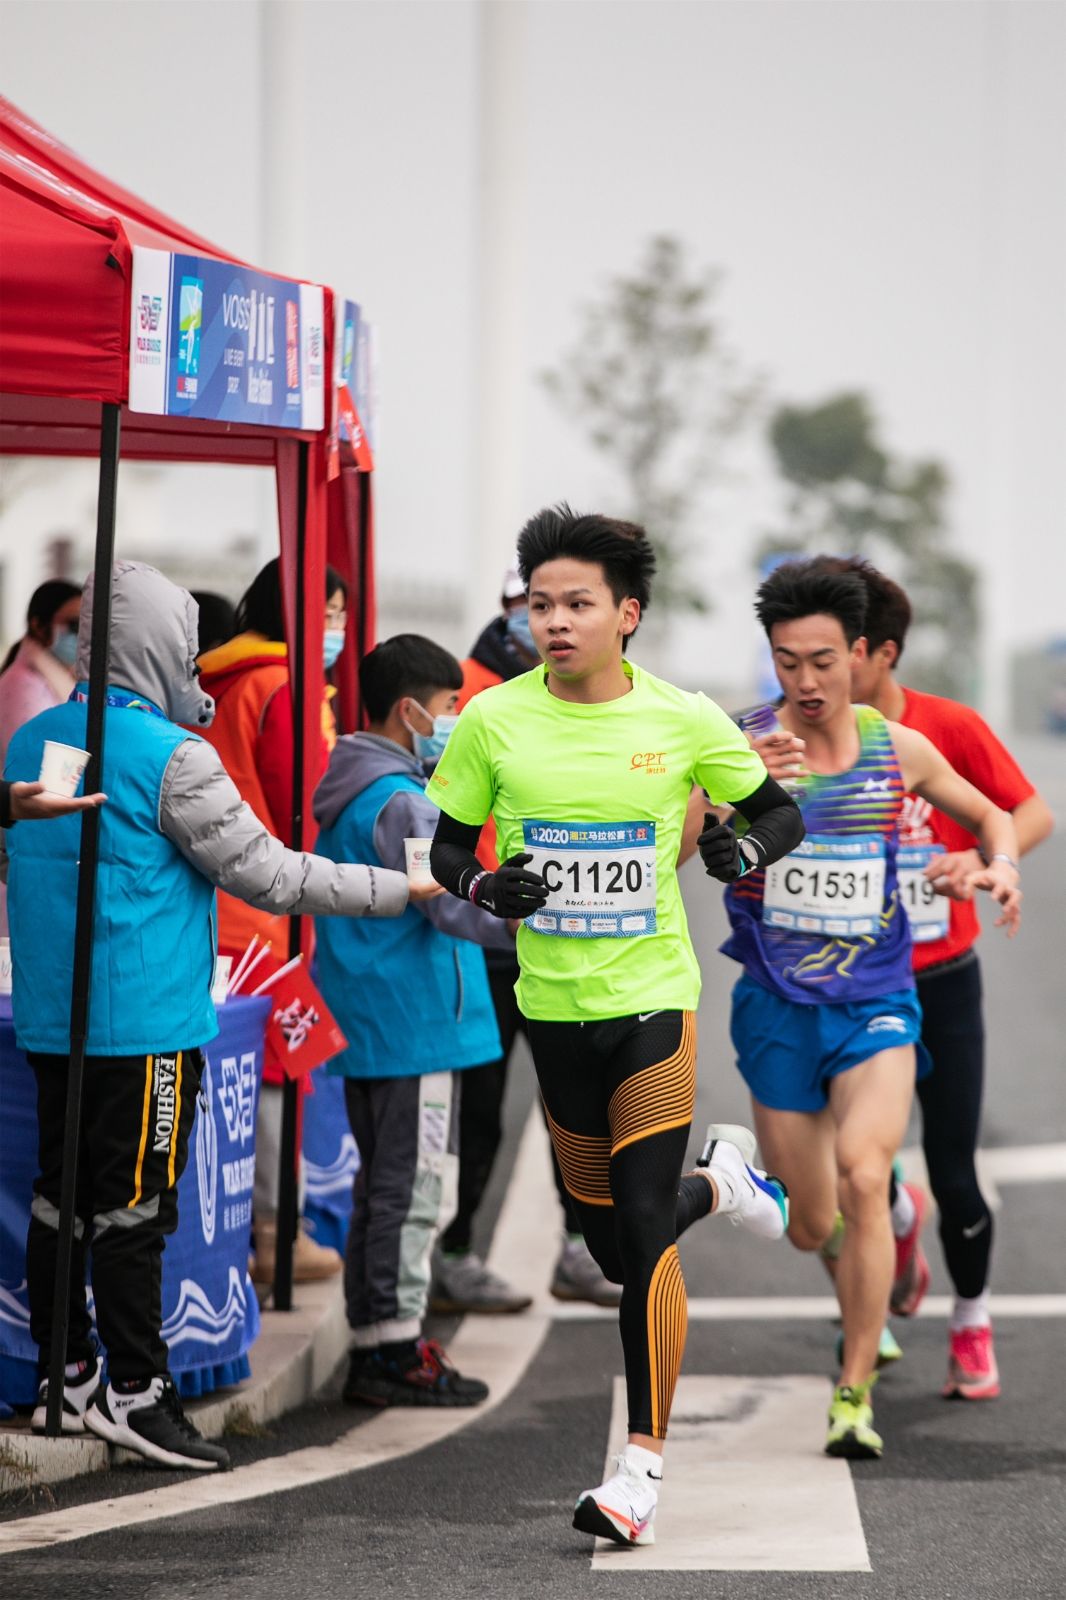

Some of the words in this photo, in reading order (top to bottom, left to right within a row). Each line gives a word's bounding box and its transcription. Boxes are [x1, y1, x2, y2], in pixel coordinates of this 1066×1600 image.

[630, 753, 667, 769] CPT
[542, 860, 642, 893] C1120
[784, 867, 870, 899] C1531
[898, 879, 936, 905] 19
[153, 1057, 176, 1153] FASHION
